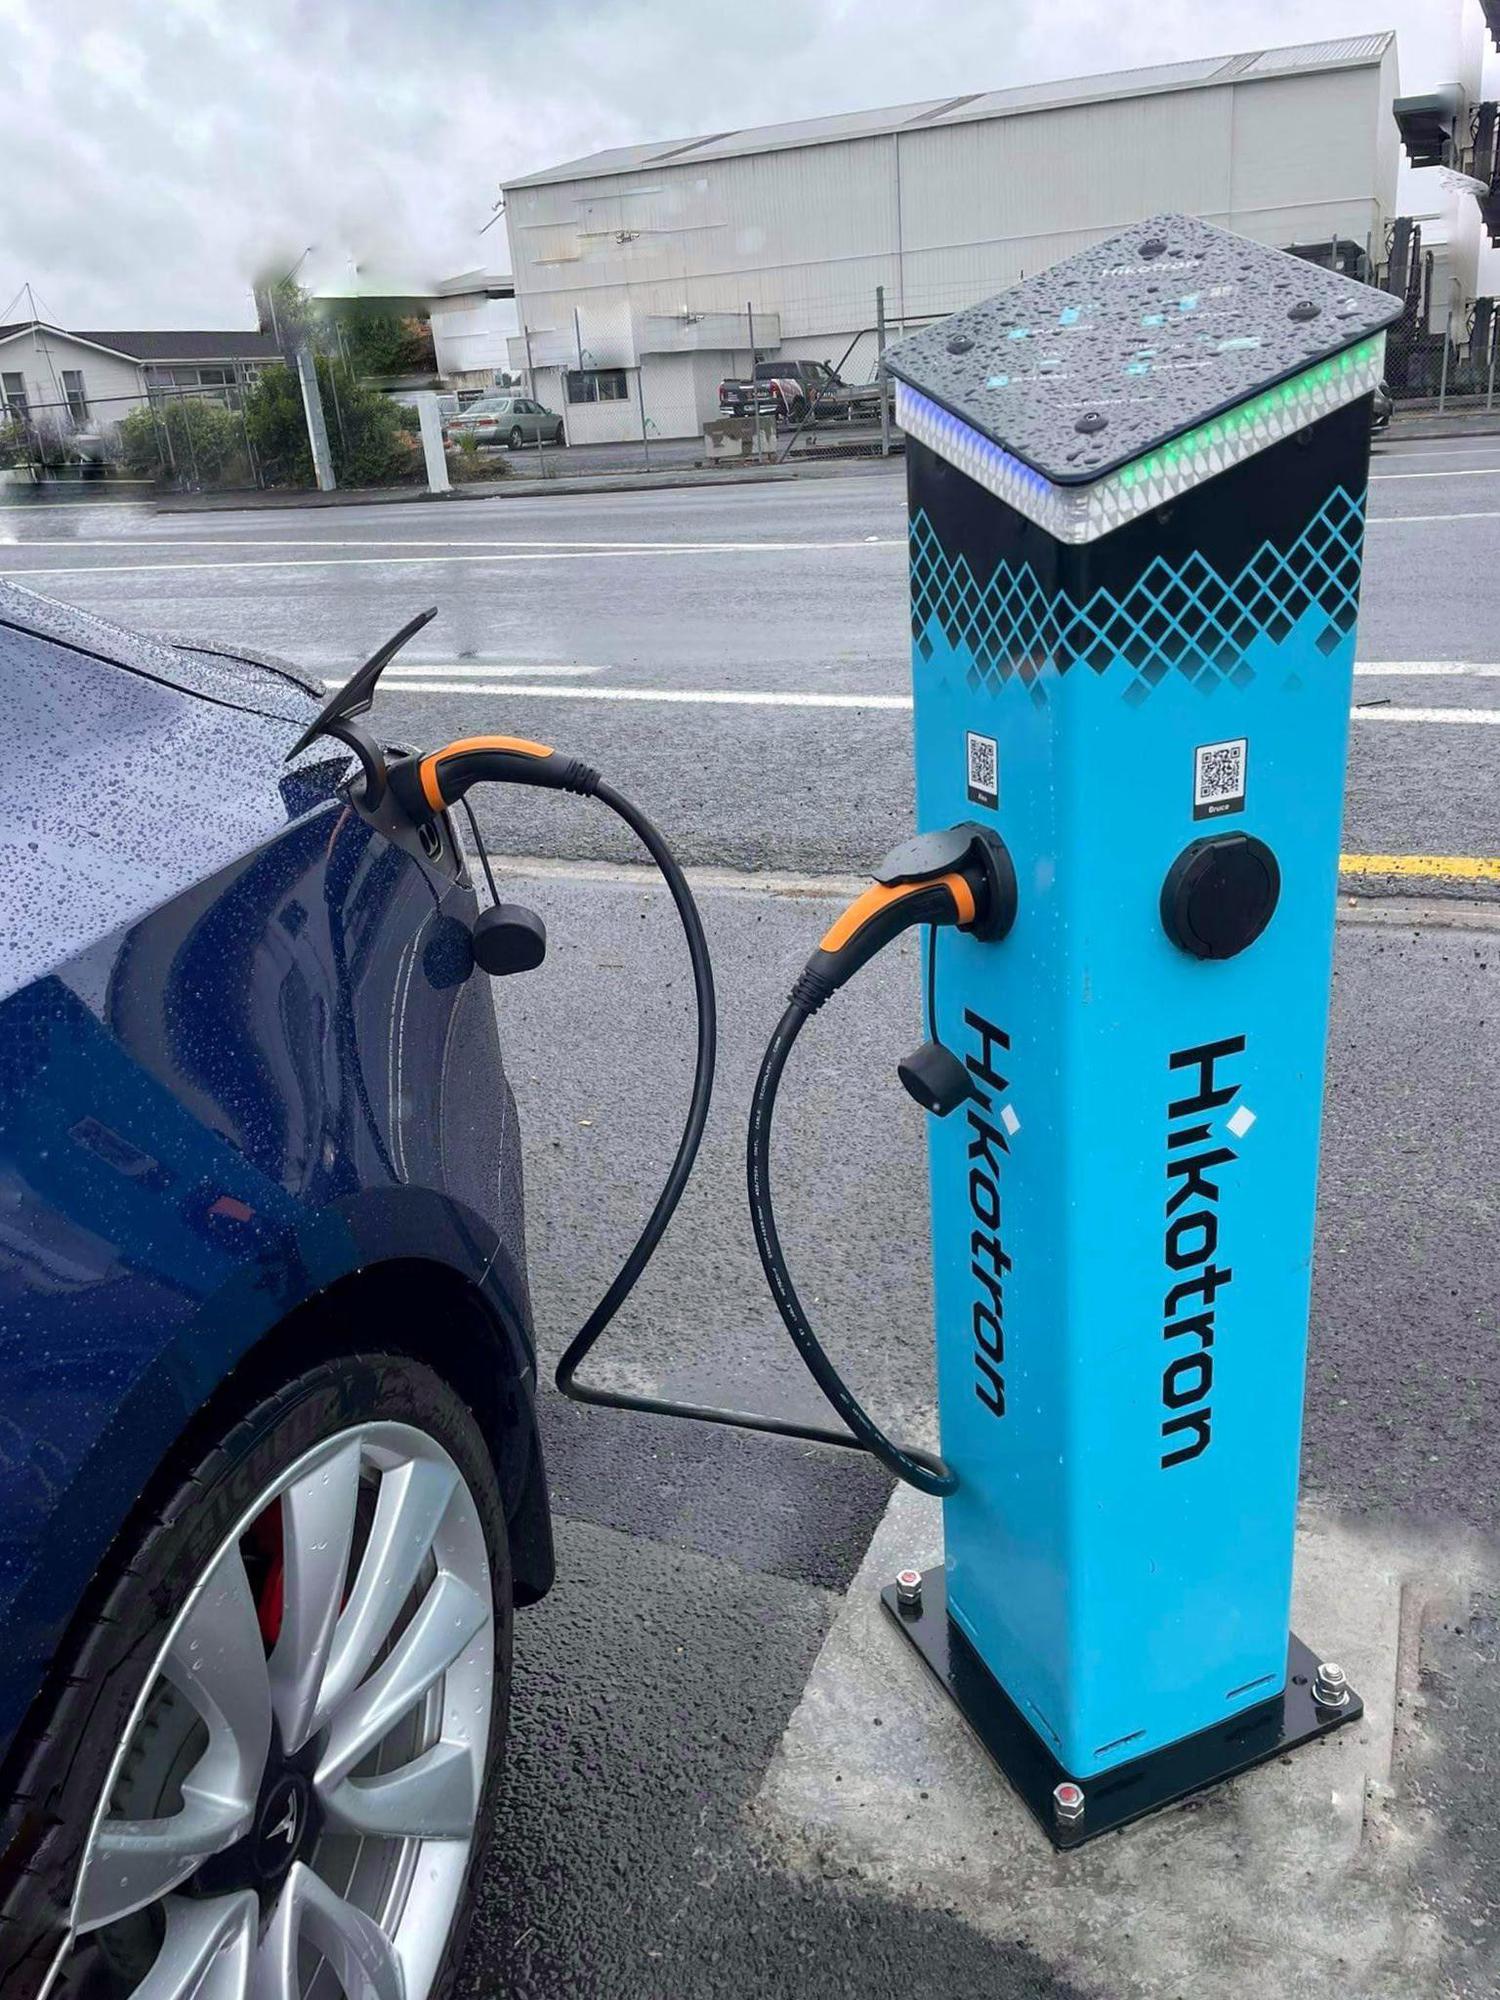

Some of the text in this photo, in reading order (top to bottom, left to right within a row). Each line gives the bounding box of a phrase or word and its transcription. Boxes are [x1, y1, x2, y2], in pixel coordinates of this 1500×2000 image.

[1208, 803, 1231, 814] Bruce
[964, 1006, 1021, 1419] Hikotron
[1161, 1033, 1257, 1470] Hikotron
